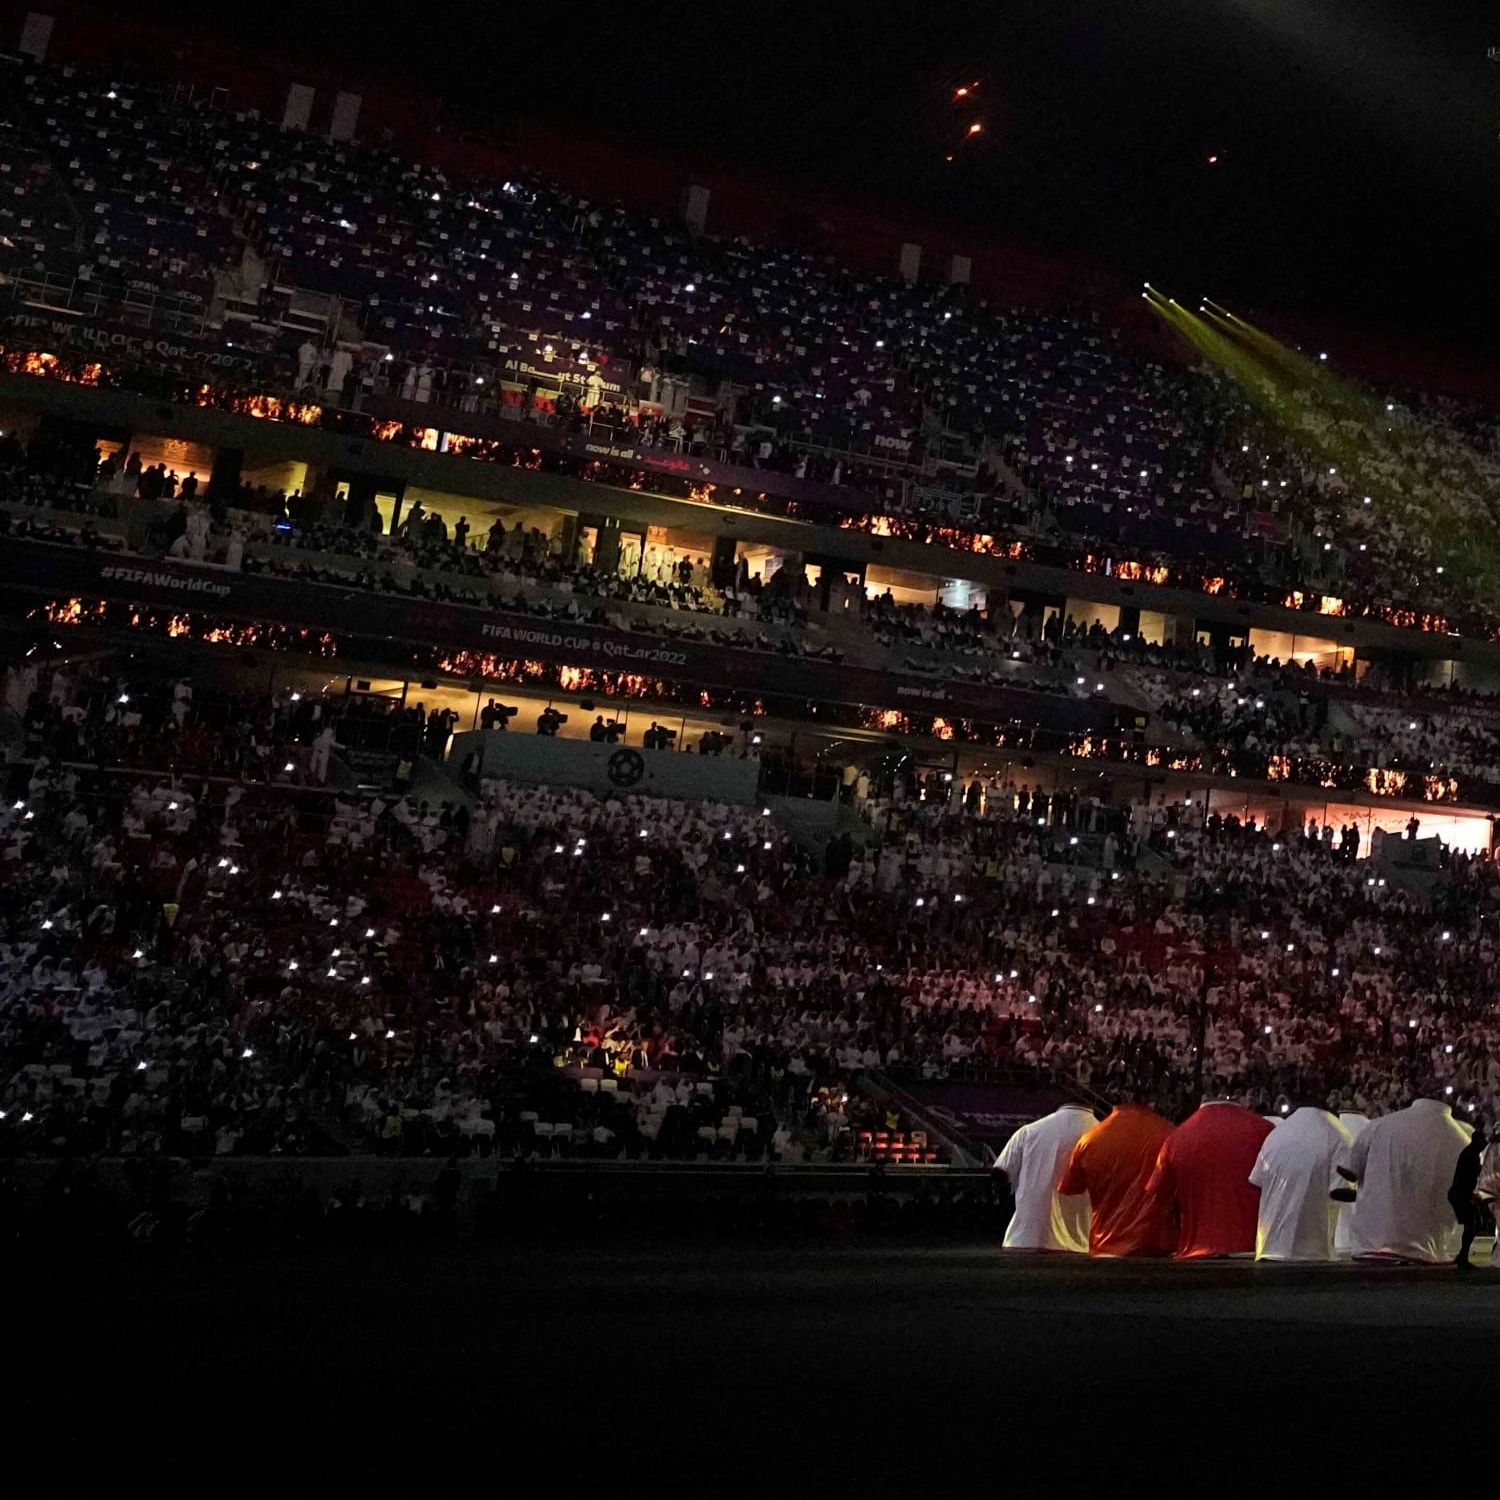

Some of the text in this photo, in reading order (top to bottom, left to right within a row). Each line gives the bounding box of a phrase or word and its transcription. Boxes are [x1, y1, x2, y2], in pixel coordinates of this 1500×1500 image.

[504, 359, 518, 370] Al
[585, 443, 634, 459] now is all
[100, 566, 232, 597] #FIFAWorldCup
[481, 623, 512, 640] FIFA
[513, 628, 562, 646] WORLD
[564, 636, 591, 650] CUP
